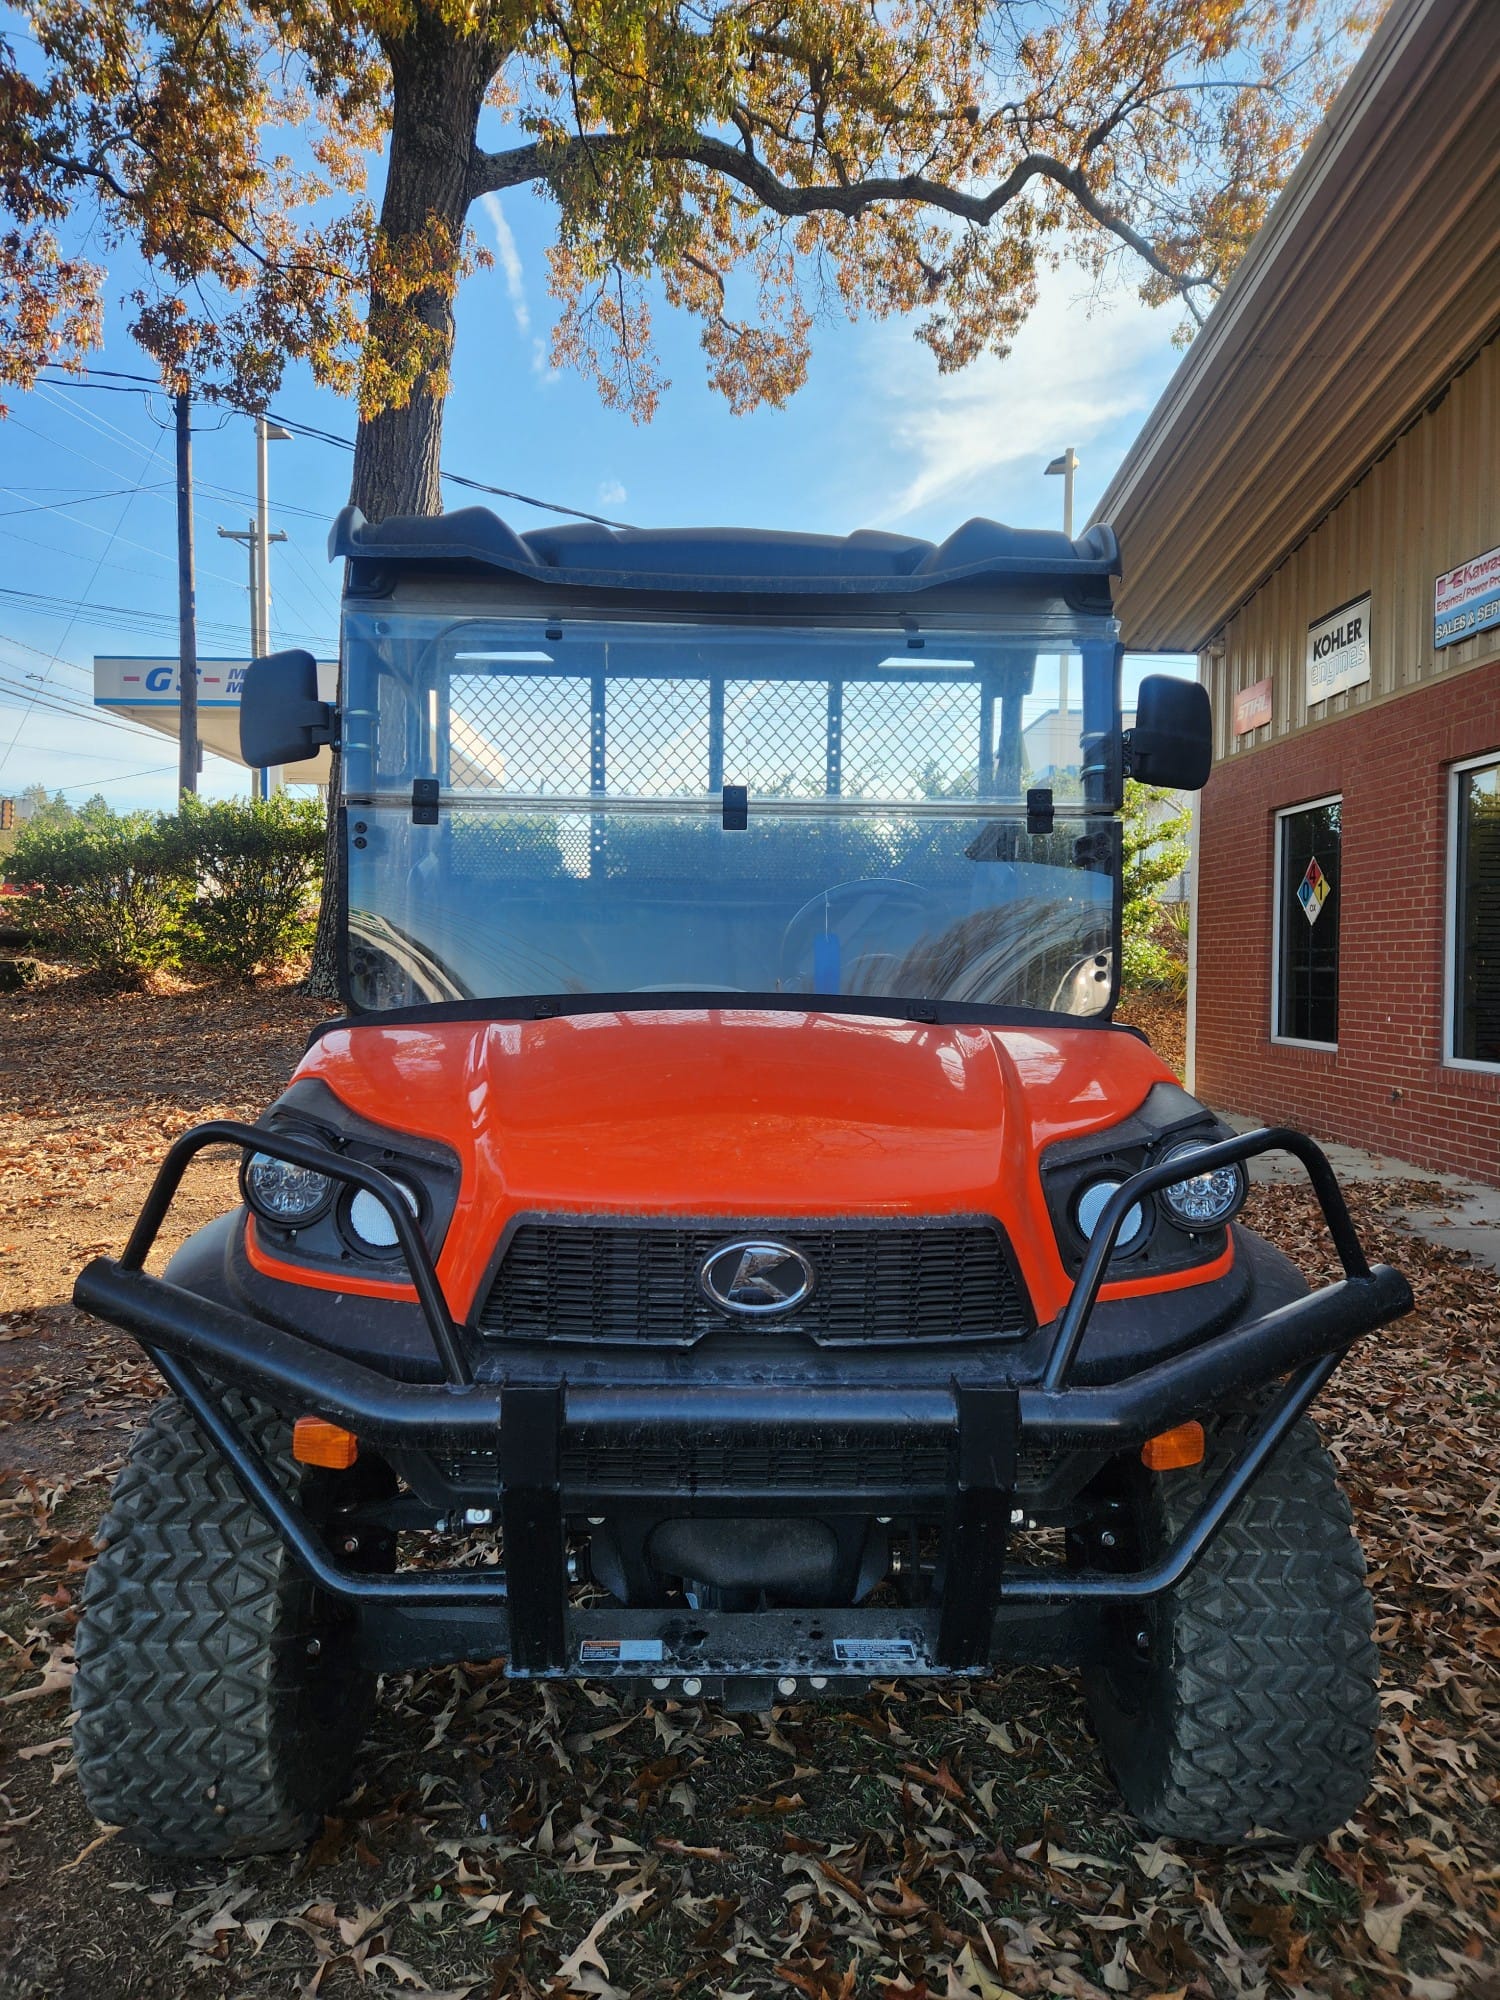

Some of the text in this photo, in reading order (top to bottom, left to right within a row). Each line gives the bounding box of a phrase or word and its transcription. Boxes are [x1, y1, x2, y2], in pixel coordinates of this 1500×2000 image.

[1436, 599, 1500, 640] SALES & SER
[1313, 617, 1362, 662] KOHLER
[1311, 641, 1367, 687] engines
[1237, 694, 1269, 721] STIHL
[1309, 864, 1316, 884] 4
[1318, 879, 1323, 901] 1
